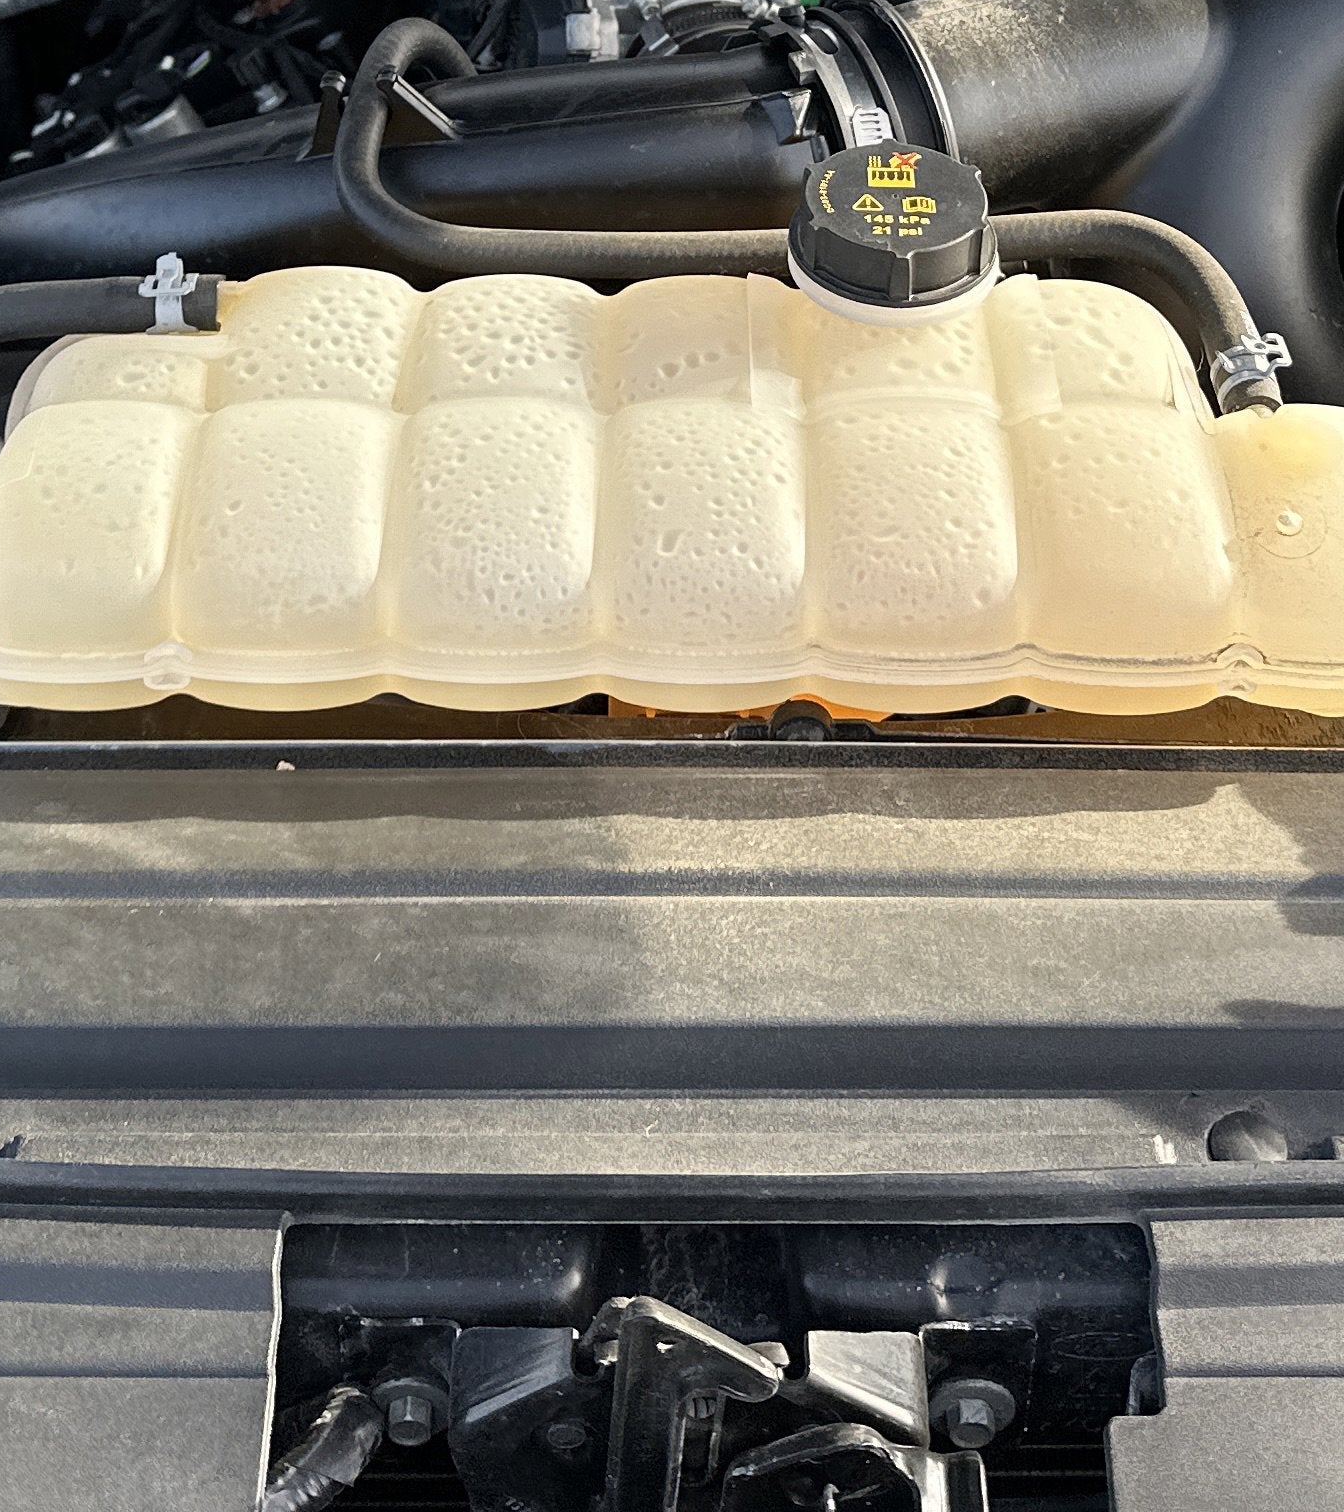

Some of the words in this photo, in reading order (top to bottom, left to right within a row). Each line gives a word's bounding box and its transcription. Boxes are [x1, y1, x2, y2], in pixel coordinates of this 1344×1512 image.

[863, 213, 894, 223] 145
[898, 215, 930, 224] kPa
[871, 225, 891, 234] 21
[897, 226, 923, 237] psi
